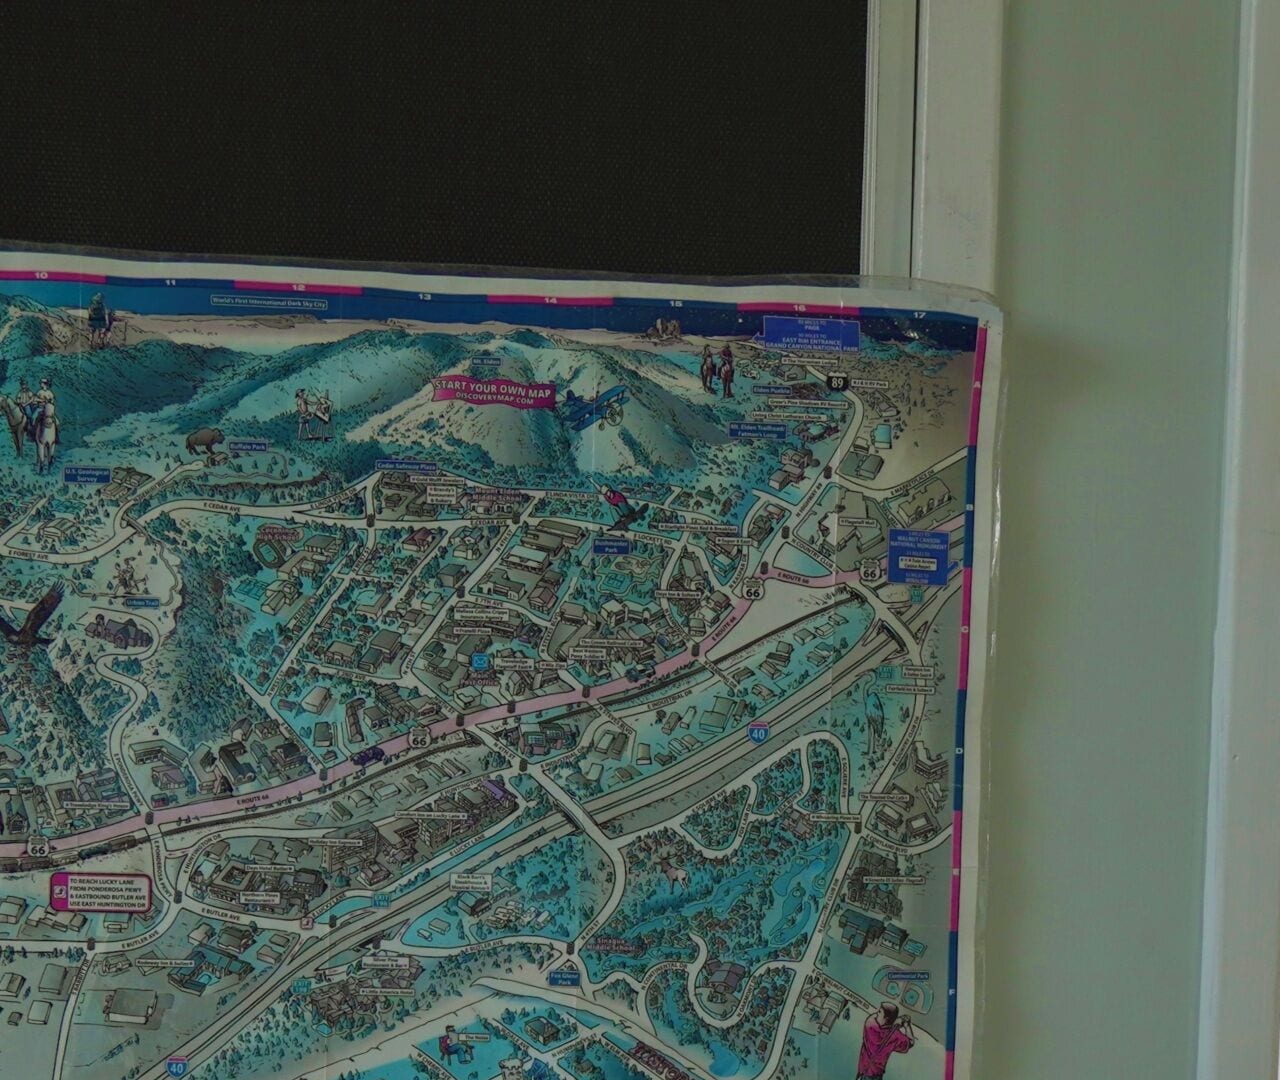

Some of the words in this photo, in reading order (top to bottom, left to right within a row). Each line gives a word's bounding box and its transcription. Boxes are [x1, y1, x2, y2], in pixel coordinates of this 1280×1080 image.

[831, 377, 844, 388] 89
[435, 381, 467, 390] START
[469, 383, 497, 393] YOUR
[500, 385, 526, 396] OWN
[528, 389, 551, 398] MAP
[31, 846, 45, 855] 66
